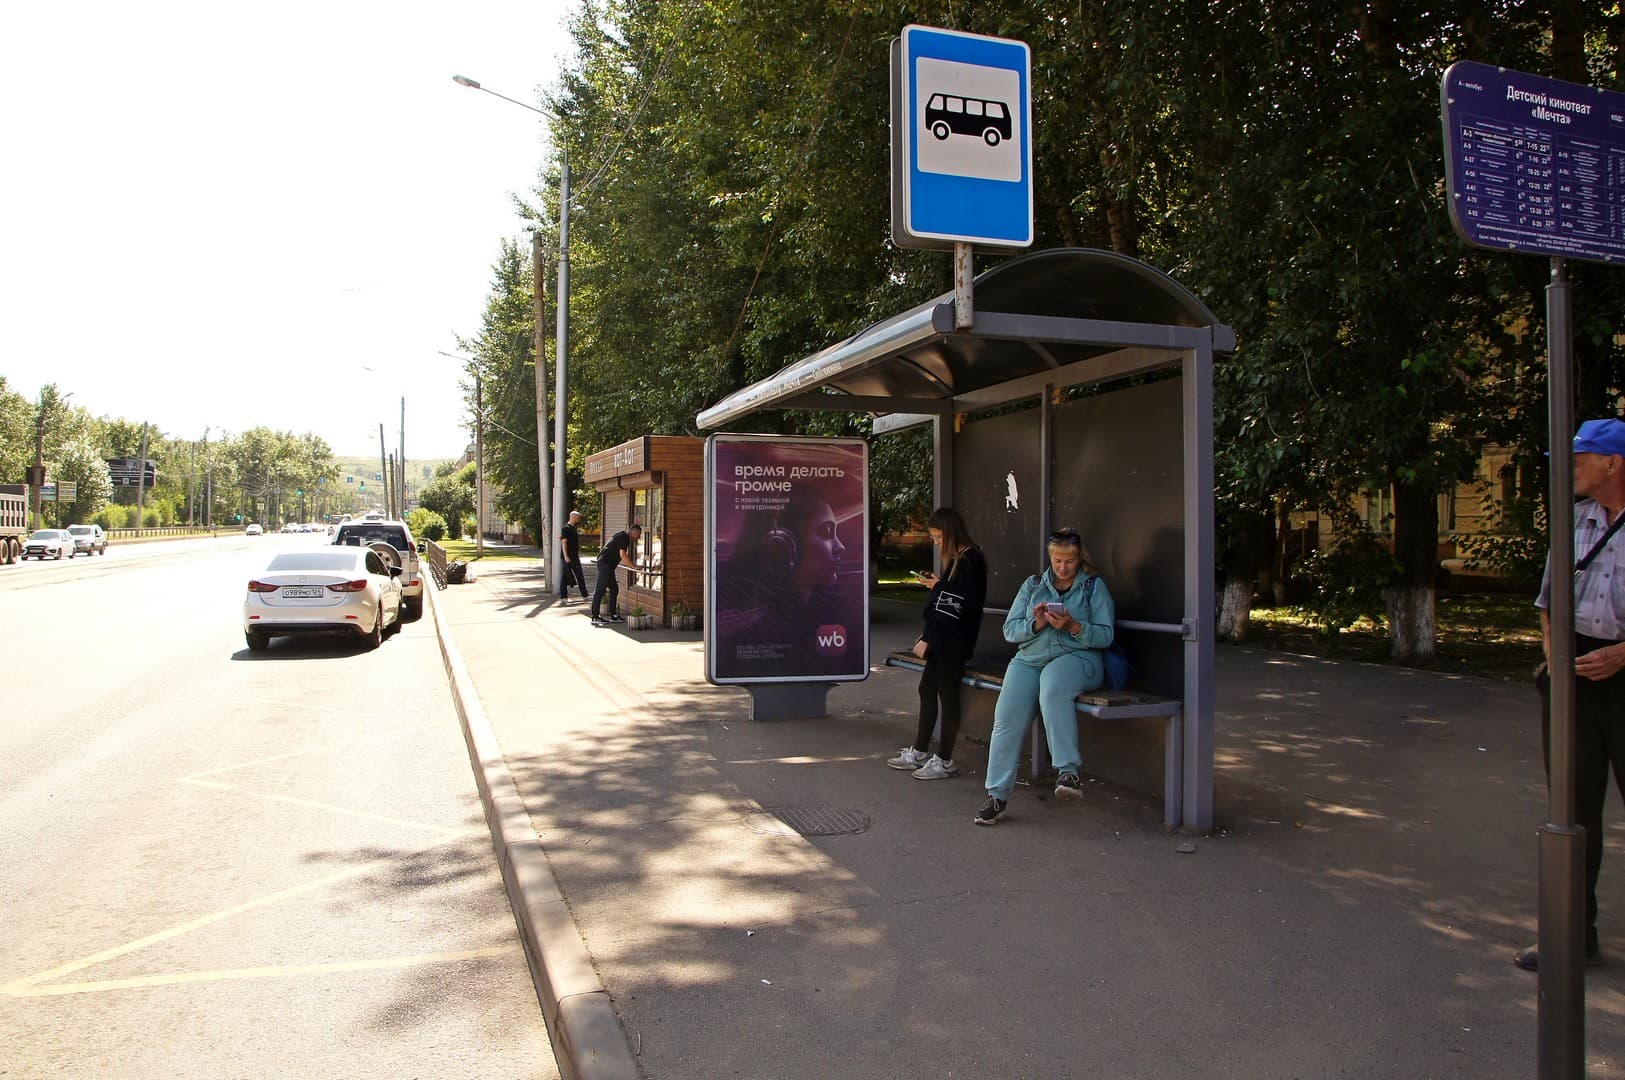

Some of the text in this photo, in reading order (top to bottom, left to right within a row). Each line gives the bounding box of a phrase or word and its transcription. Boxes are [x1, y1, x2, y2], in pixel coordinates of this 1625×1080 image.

[1506, 85, 1592, 115] Детский кинотеат
[1531, 106, 1571, 125] «Мечта»
[735, 465, 845, 479] время делать
[735, 480, 792, 495] громче
[818, 631, 845, 647] wb
